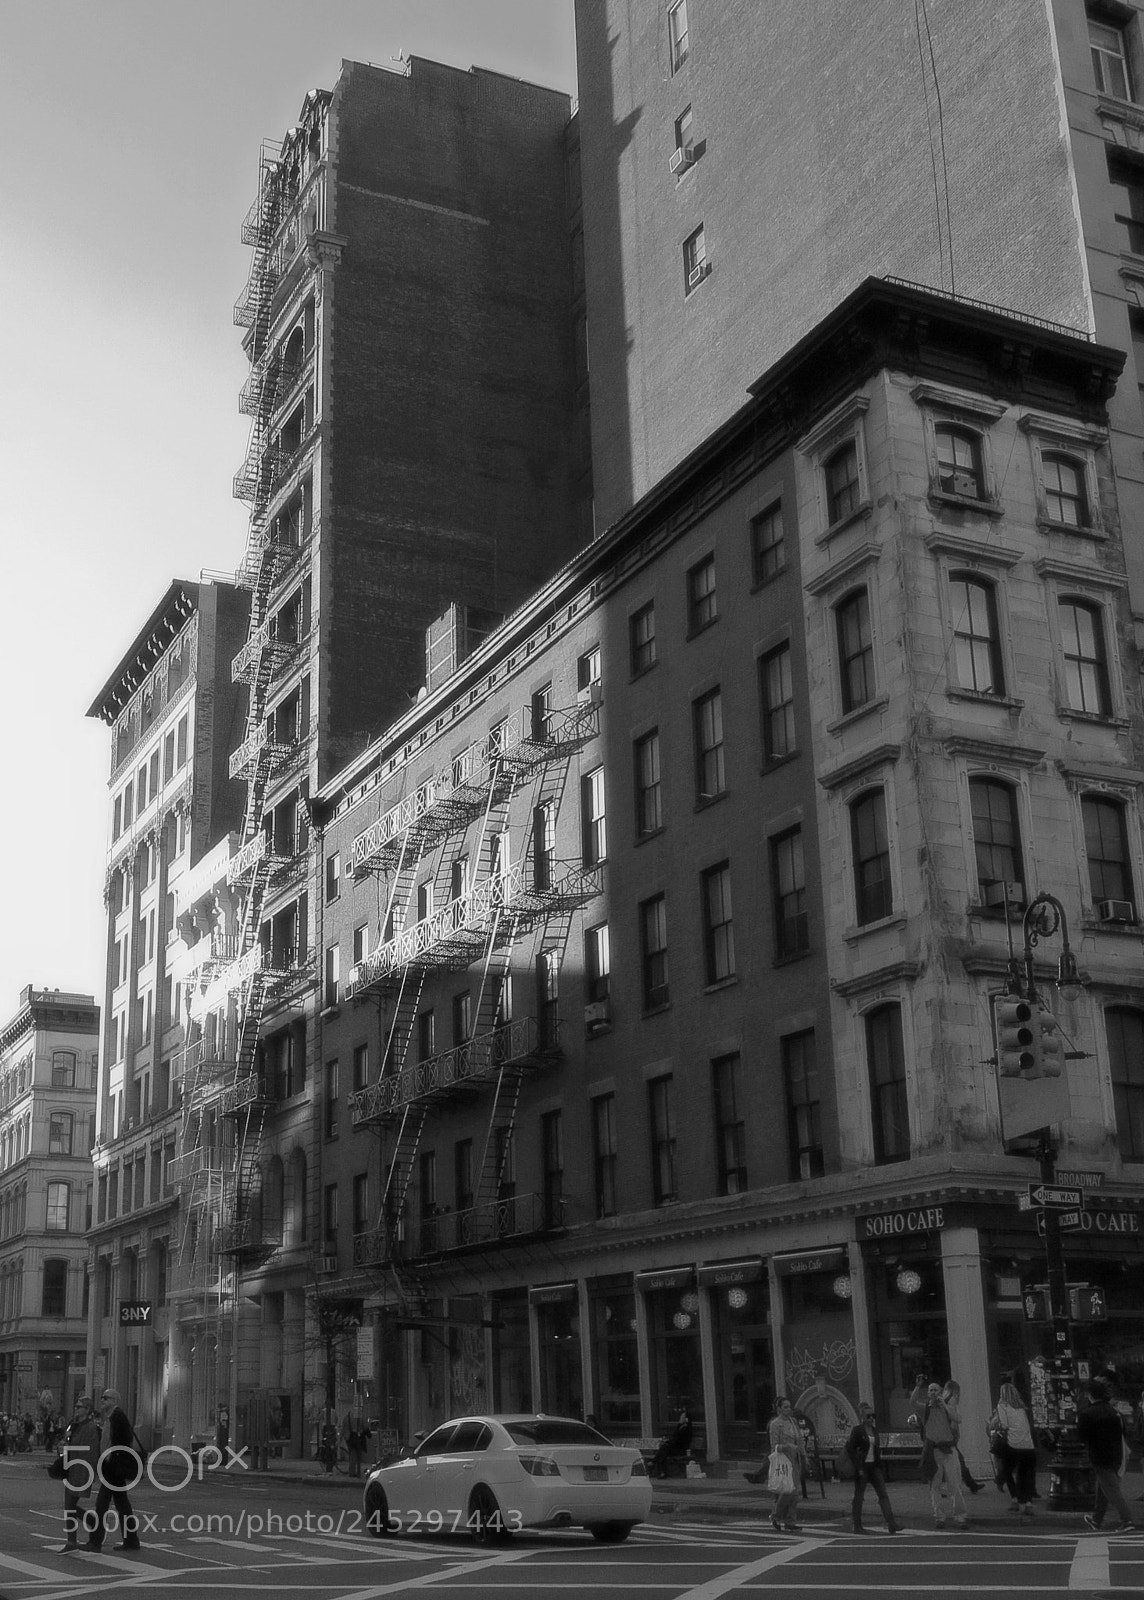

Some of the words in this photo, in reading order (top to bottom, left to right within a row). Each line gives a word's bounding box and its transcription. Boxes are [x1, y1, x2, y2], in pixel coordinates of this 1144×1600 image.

[1058, 1172, 1102, 1187] BROADWAY
[1037, 1190, 1053, 1200] ONE
[1059, 1192, 1077, 1202] WAY
[866, 1213, 905, 1237] SOHO
[907, 1207, 945, 1231] CAFE
[1062, 1214, 1076, 1224] WAY
[1096, 1211, 1139, 1232] CAFE
